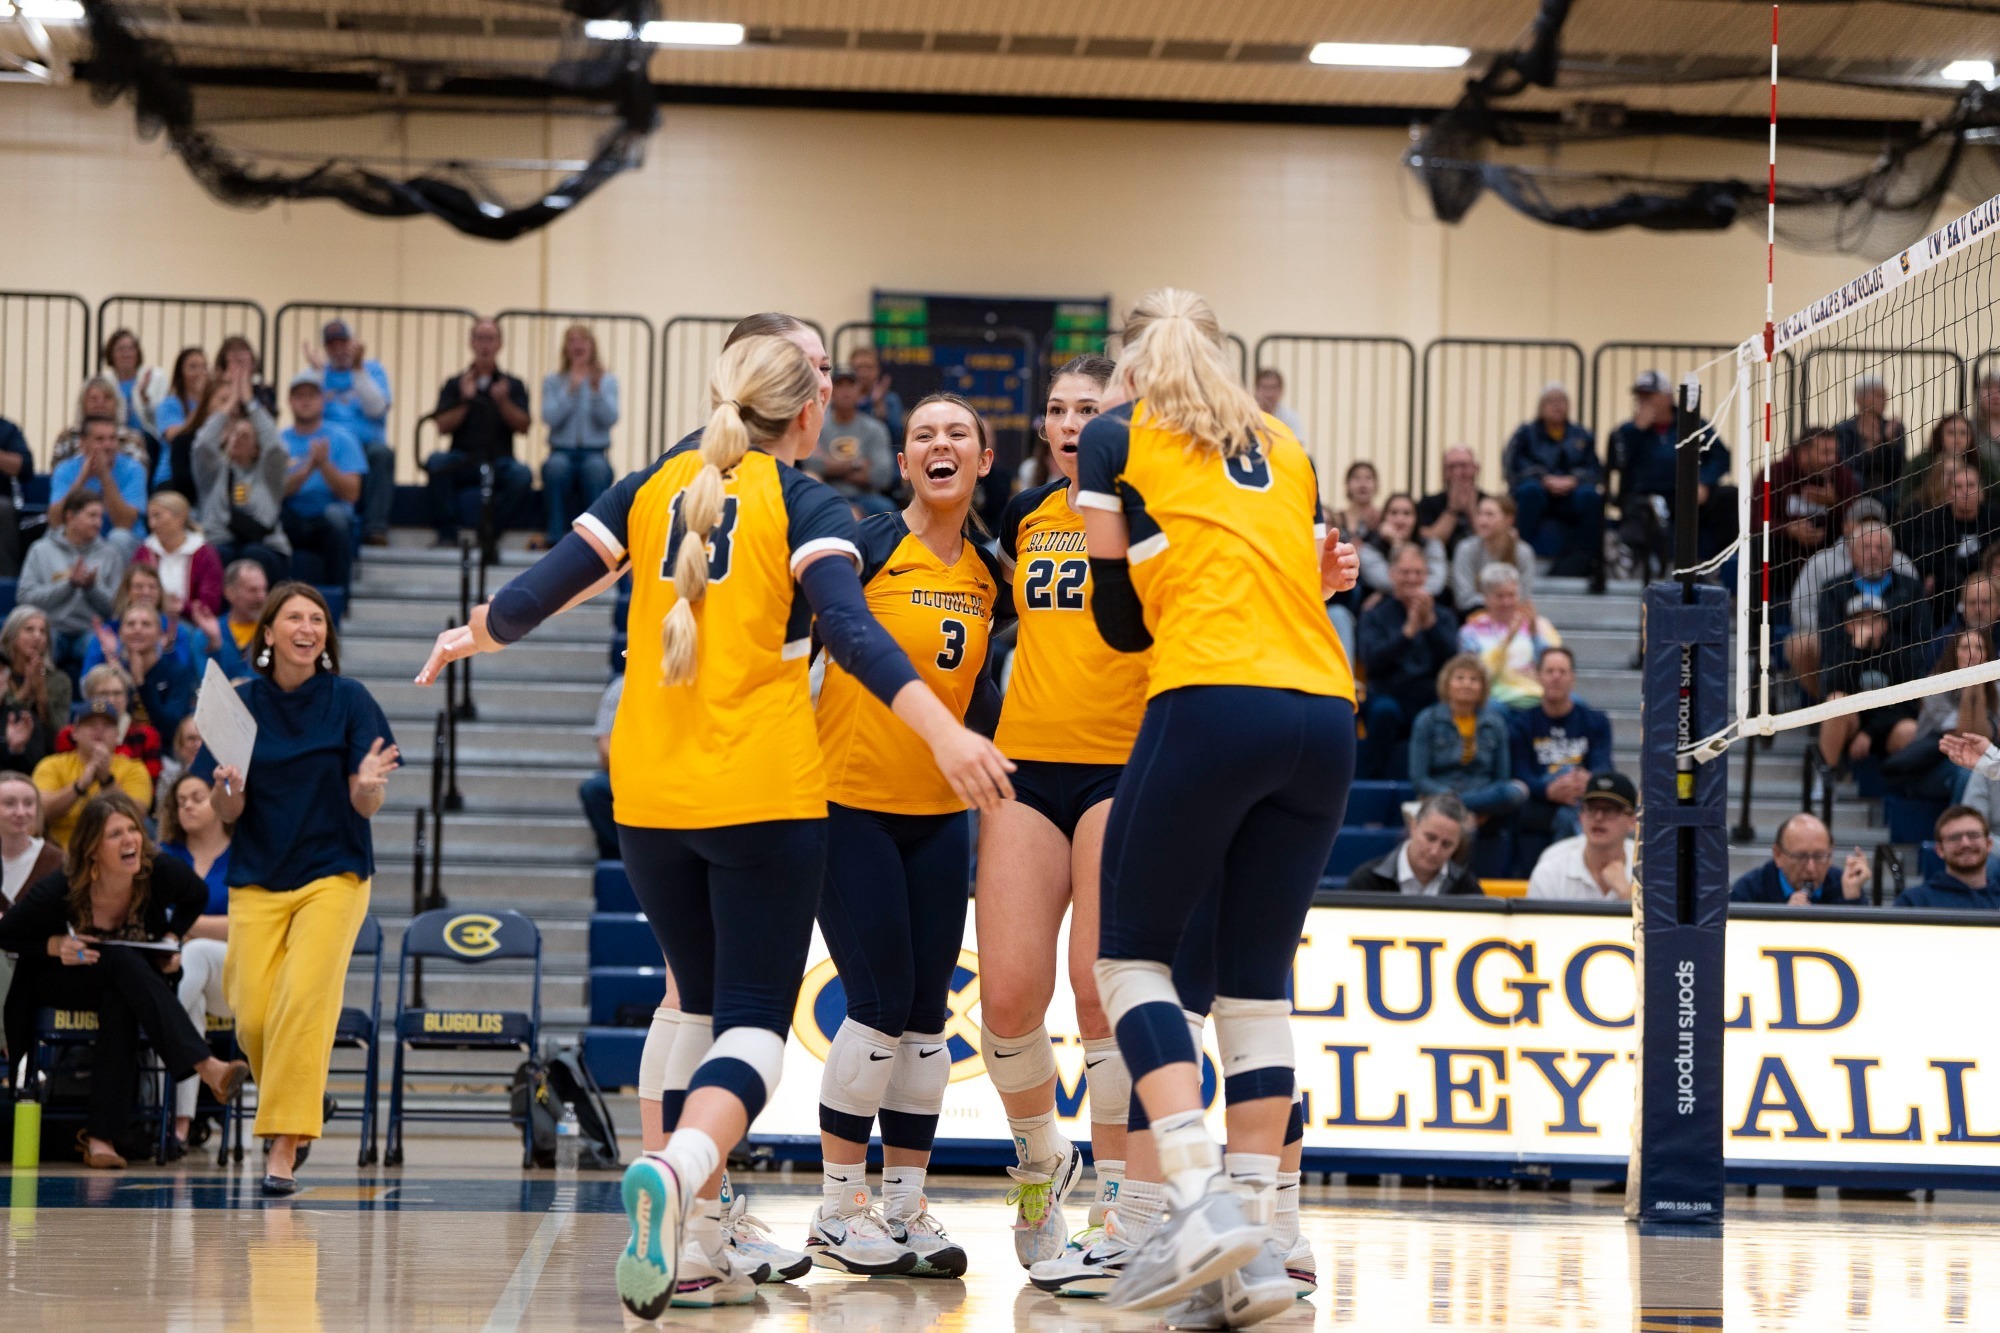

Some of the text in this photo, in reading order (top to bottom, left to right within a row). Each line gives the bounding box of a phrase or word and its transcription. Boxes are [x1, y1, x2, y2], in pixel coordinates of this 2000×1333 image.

[1026, 530, 1088, 553] BLUGOL
[1024, 557, 1088, 612] 22
[935, 617, 967, 672] 3
[423, 1012, 504, 1034] BLUGOLDS
[1674, 960, 1698, 1115] sports imports
[1655, 1201, 1676, 1210] (800)
